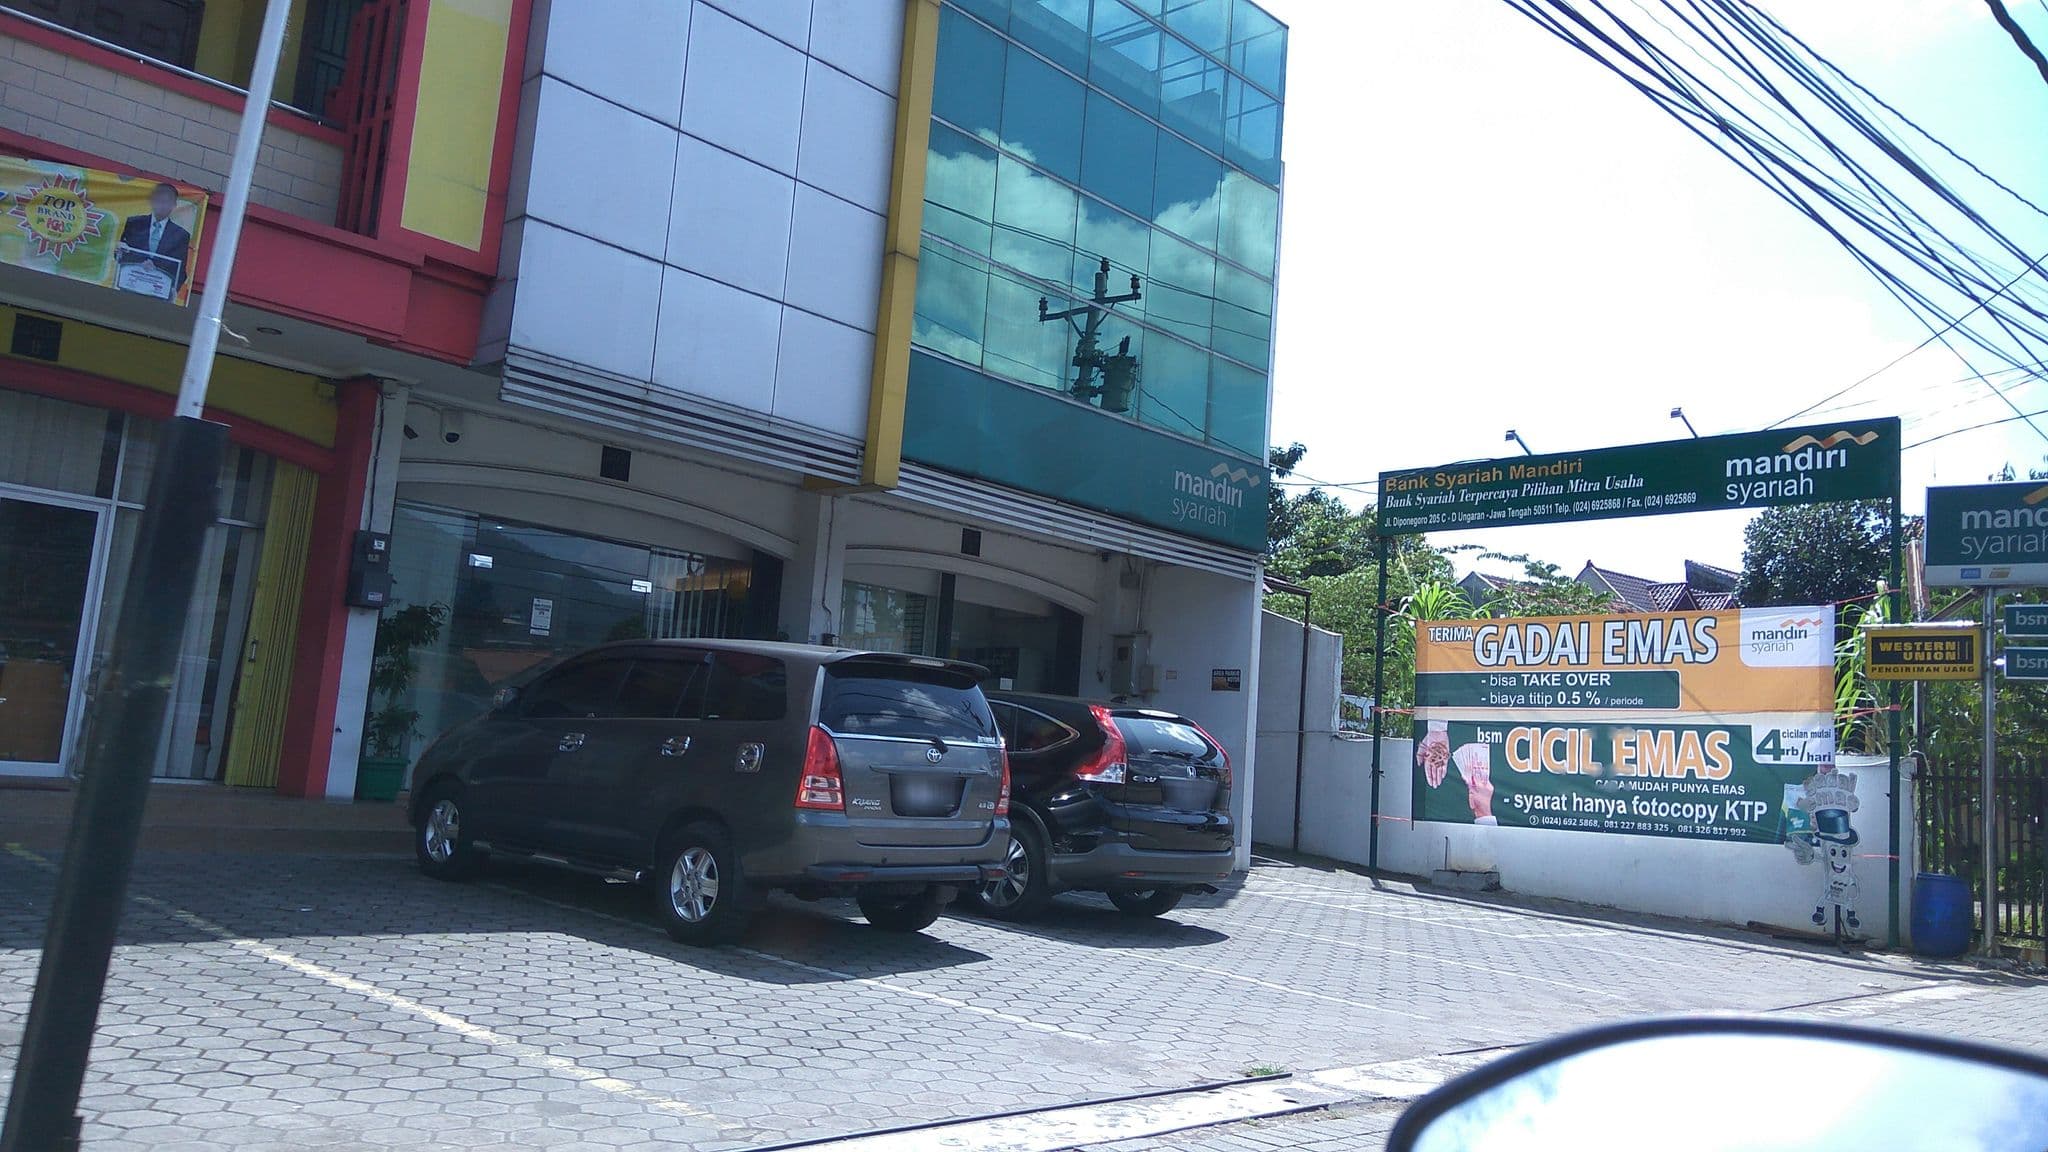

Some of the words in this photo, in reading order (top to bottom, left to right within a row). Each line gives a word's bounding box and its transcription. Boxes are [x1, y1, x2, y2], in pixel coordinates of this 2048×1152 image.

[43, 195, 76, 211] TOP
[37, 206, 76, 221] BRAND
[1727, 448, 1846, 477] mandiri
[1385, 475, 1429, 492] Bank
[1435, 467, 1502, 490] Syariah
[1510, 458, 1583, 480] Mandiri
[1174, 470, 1243, 508] mandiri
[1385, 493, 1412, 509] Bank
[1415, 490, 1455, 509] Syariah
[1459, 486, 1519, 506] Terpercaya
[1522, 481, 1564, 497] Pilihan
[1567, 478, 1600, 494] Mitra
[1605, 474, 1644, 490] Usaha
[1726, 473, 1814, 505] syariah
[1172, 497, 1227, 527] syariah
[1393, 514, 1428, 529] Diponegoro
[1429, 513, 1440, 525] 205
[1441, 512, 1447, 524] C
[1452, 511, 1457, 522] D
[1458, 509, 1485, 524] Ungaran
[1508, 504, 1532, 519] Tengah
[1533, 503, 1553, 516] 50511
[1555, 501, 1571, 516] Telp.
[1573, 498, 1591, 515] (024)
[1592, 497, 1621, 511] 6925868
[1627, 495, 1643, 508] Fax.
[1644, 493, 1664, 509] (024)
[1665, 490, 1697, 505] 6925869
[1428, 625, 1474, 643] TERIMA
[1473, 620, 1591, 667] GADAI
[1602, 616, 1718, 666] EMAS
[1751, 626, 1808, 642] mandiri
[1750, 640, 1795, 654] syariah
[1880, 641, 1957, 652] WESTERN
[1903, 651, 1957, 661] UNION
[1943, 665, 1975, 673] UANG
[1489, 674, 1517, 687] bisa
[1521, 673, 1561, 687] TAKE
[1565, 672, 1611, 687] OVER
[1490, 692, 1525, 707] biaya
[1529, 692, 1553, 706] titip
[1557, 691, 1581, 705] 0.5
[1585, 690, 1601, 705] %
[1610, 696, 1644, 707] periode
[1782, 729, 1809, 739] cicilan
[1810, 729, 1832, 739] mulai
[1477, 726, 1503, 743] bsm
[1505, 726, 1603, 776] CICIL
[1613, 728, 1733, 781] EMAS
[1628, 781, 1669, 793] MUDAH
[1672, 783, 1710, 794] PUNYA
[1712, 785, 1746, 796] EMAS
[1513, 793, 1568, 813] syarat
[1572, 792, 1628, 819] hanya
[1631, 795, 1719, 824] fotocopy
[1725, 801, 1768, 822] KTP
[1541, 814, 1562, 827] (024)
[1563, 818, 1578, 826] 692
[1578, 818, 1600, 829] 5868,
[1604, 821, 1618, 829] 081
[1620, 822, 1635, 830] 227
[1637, 823, 1652, 831] 883
[1653, 824, 1669, 832] 325
[1678, 825, 1693, 833] 081
[1695, 826, 1711, 835] 326
[1712, 827, 1728, 836] 817
[1729, 828, 1747, 837] 992
